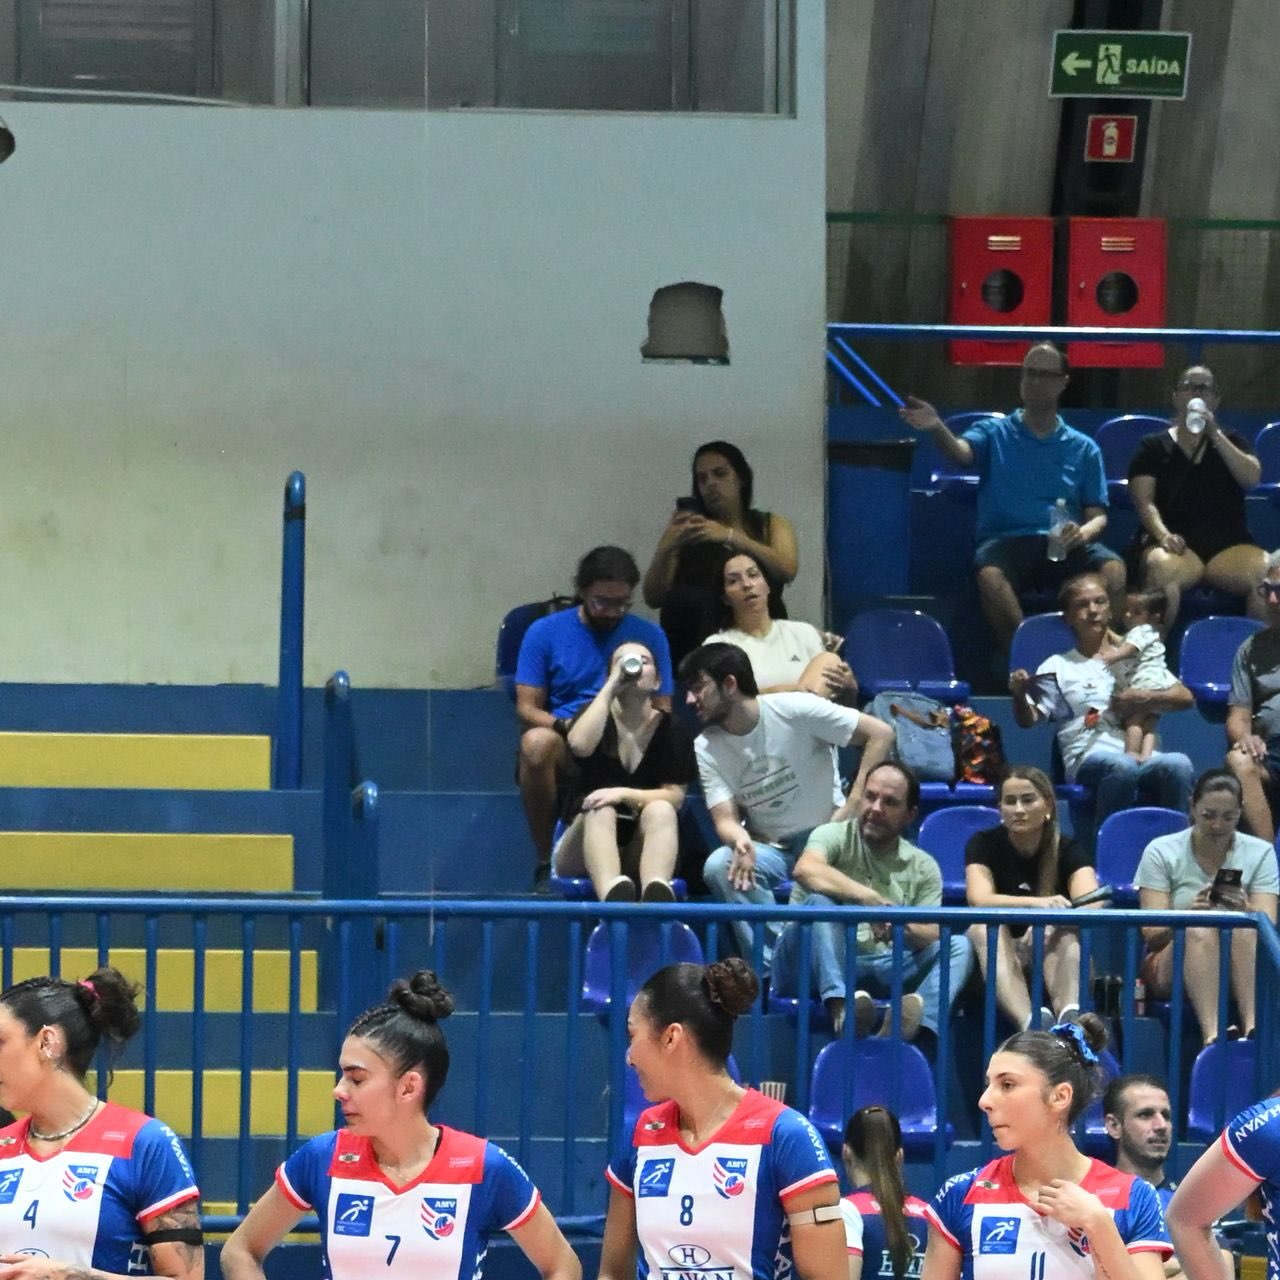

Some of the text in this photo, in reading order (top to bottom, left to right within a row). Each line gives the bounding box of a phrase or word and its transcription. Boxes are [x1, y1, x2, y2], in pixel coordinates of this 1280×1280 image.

[1125, 56, 1181, 76] SAÍDA
[797, 1116, 826, 1162] HAVAN
[727, 1161, 746, 1169] AMV
[23, 1200, 39, 1230] 4
[434, 1200, 456, 1209] AMV
[679, 1194, 694, 1226] 8
[385, 1234, 401, 1267] 7
[682, 1247, 696, 1265] H
